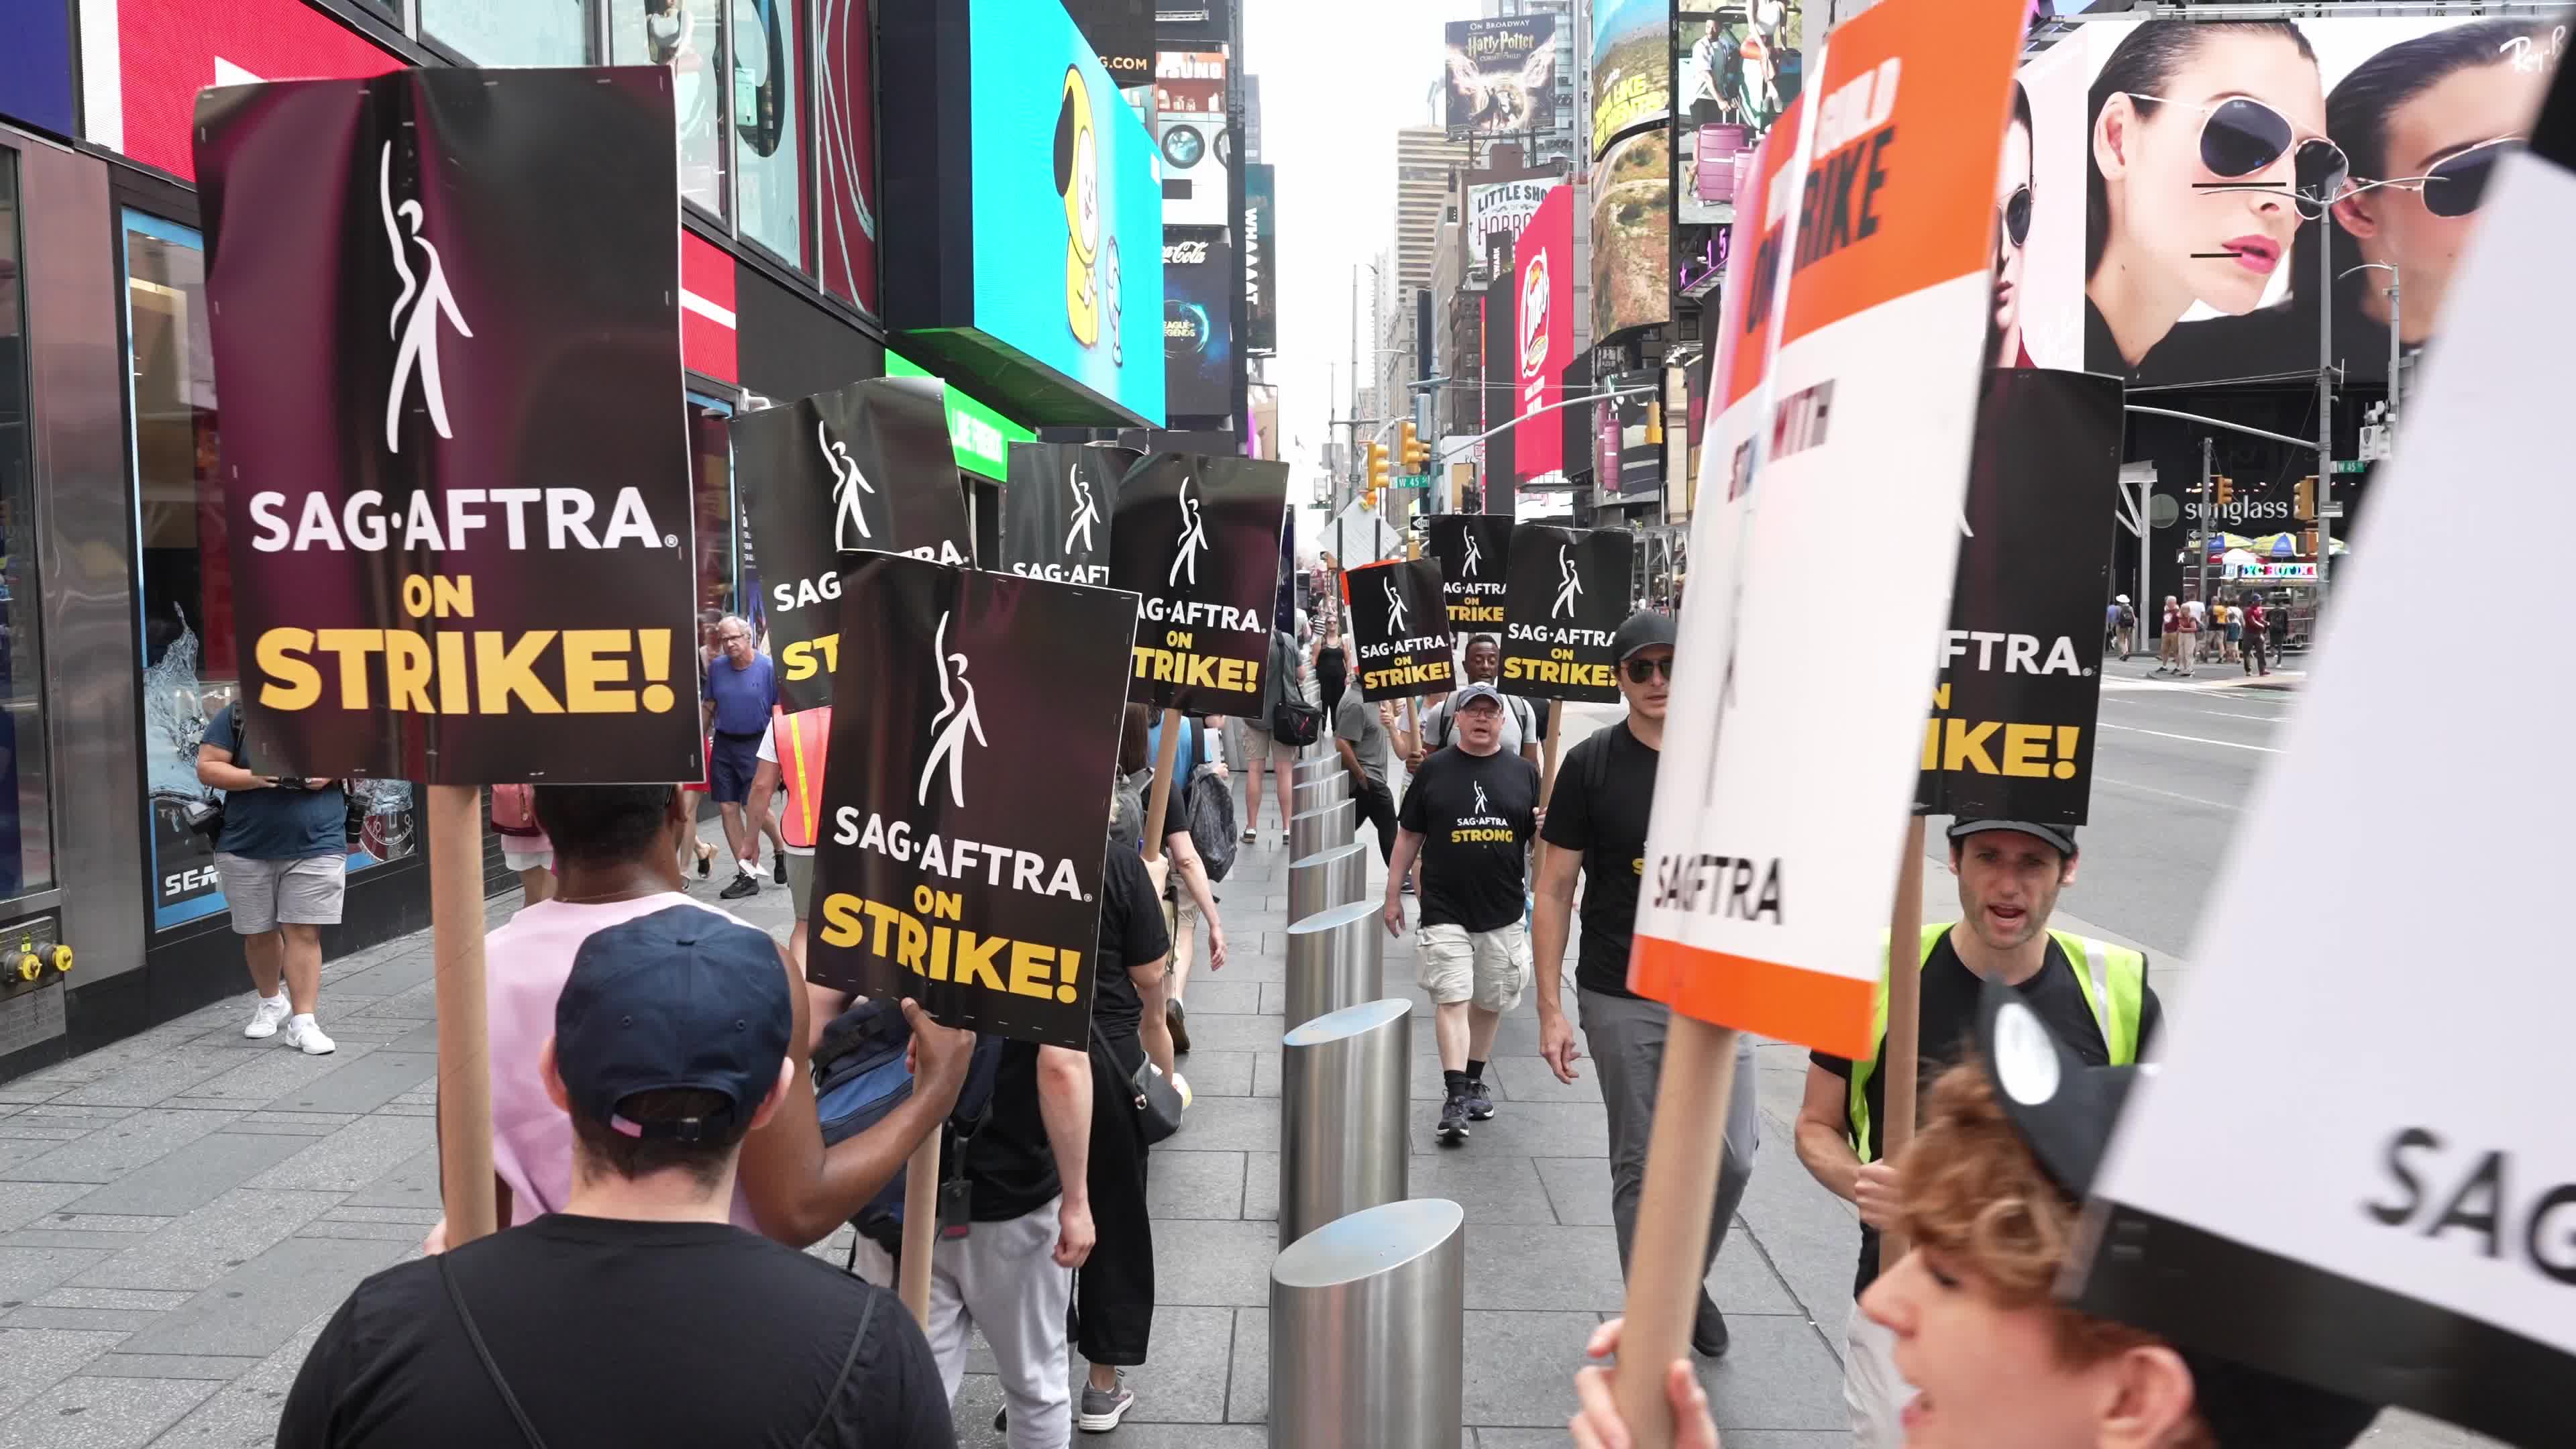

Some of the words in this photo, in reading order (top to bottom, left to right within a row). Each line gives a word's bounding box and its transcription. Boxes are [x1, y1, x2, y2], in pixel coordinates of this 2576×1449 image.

[1486, 19, 1530, 30] BROADWAY
[1467, 36, 1499, 56] Harry
[1499, 31, 1536, 50] Potter
[1478, 185, 1521, 213] LITTLE
[1245, 207, 1258, 305] WHAAAAT
[1399, 478, 1406, 487] W
[1410, 477, 1419, 486] 45
[403, 574, 474, 618] ON
[1464, 597, 1480, 606] ON
[1446, 605, 1503, 622] TRIKE
[1166, 630, 1193, 649] ON
[1394, 655, 1412, 666] ON
[1551, 648, 1574, 661] ON
[256, 627, 675, 714] STRIKE!
[1133, 646, 1259, 693] TRIKE!
[1364, 661, 1451, 690] STRIKE!
[1933, 682, 1951, 710] N
[1921, 718, 2080, 780] IKE!
[1451, 828, 1514, 843] STRONG
[914, 885, 963, 921] ON
[820, 893, 1081, 1004] STRIKE!
